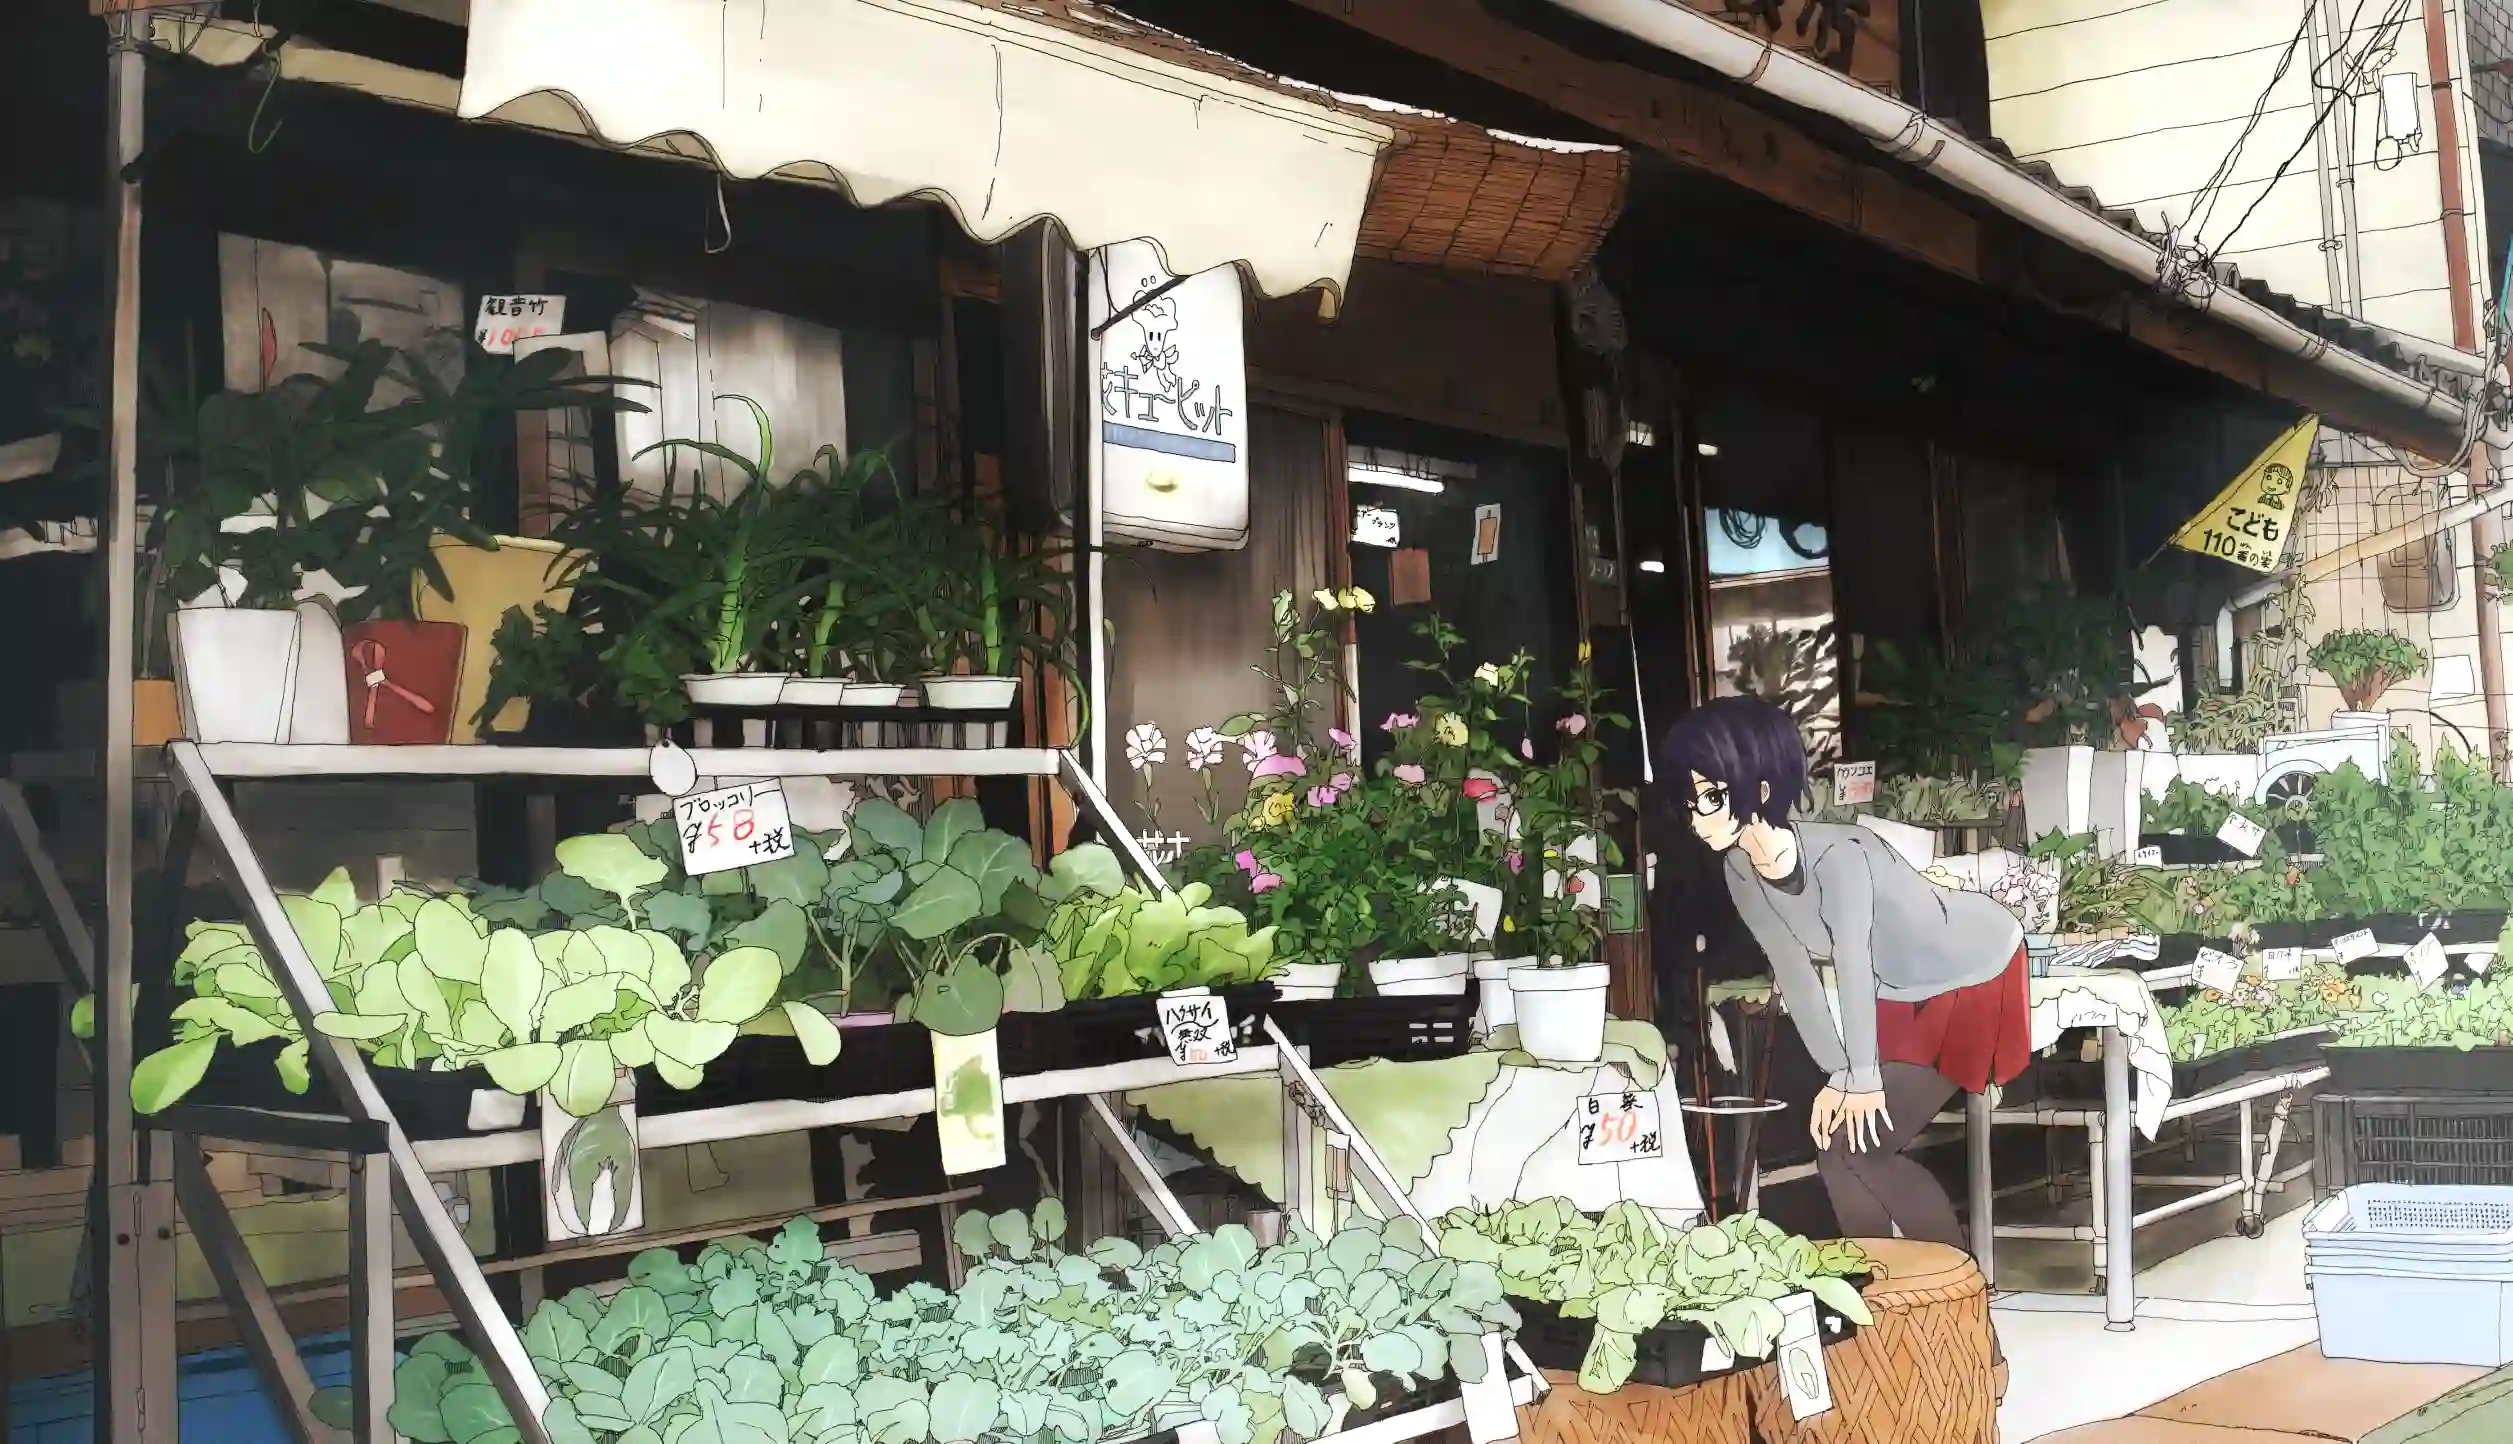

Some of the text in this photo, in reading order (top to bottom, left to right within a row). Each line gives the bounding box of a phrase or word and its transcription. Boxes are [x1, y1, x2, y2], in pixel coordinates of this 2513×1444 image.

[485, 296, 549, 317] 観音竹
[2226, 506, 2279, 542] こども
[680, 785, 781, 821] ブロッコリー
[1166, 1001, 1213, 1025] ハクサイ
[1580, 1110, 1661, 1154] ¥50 +税
